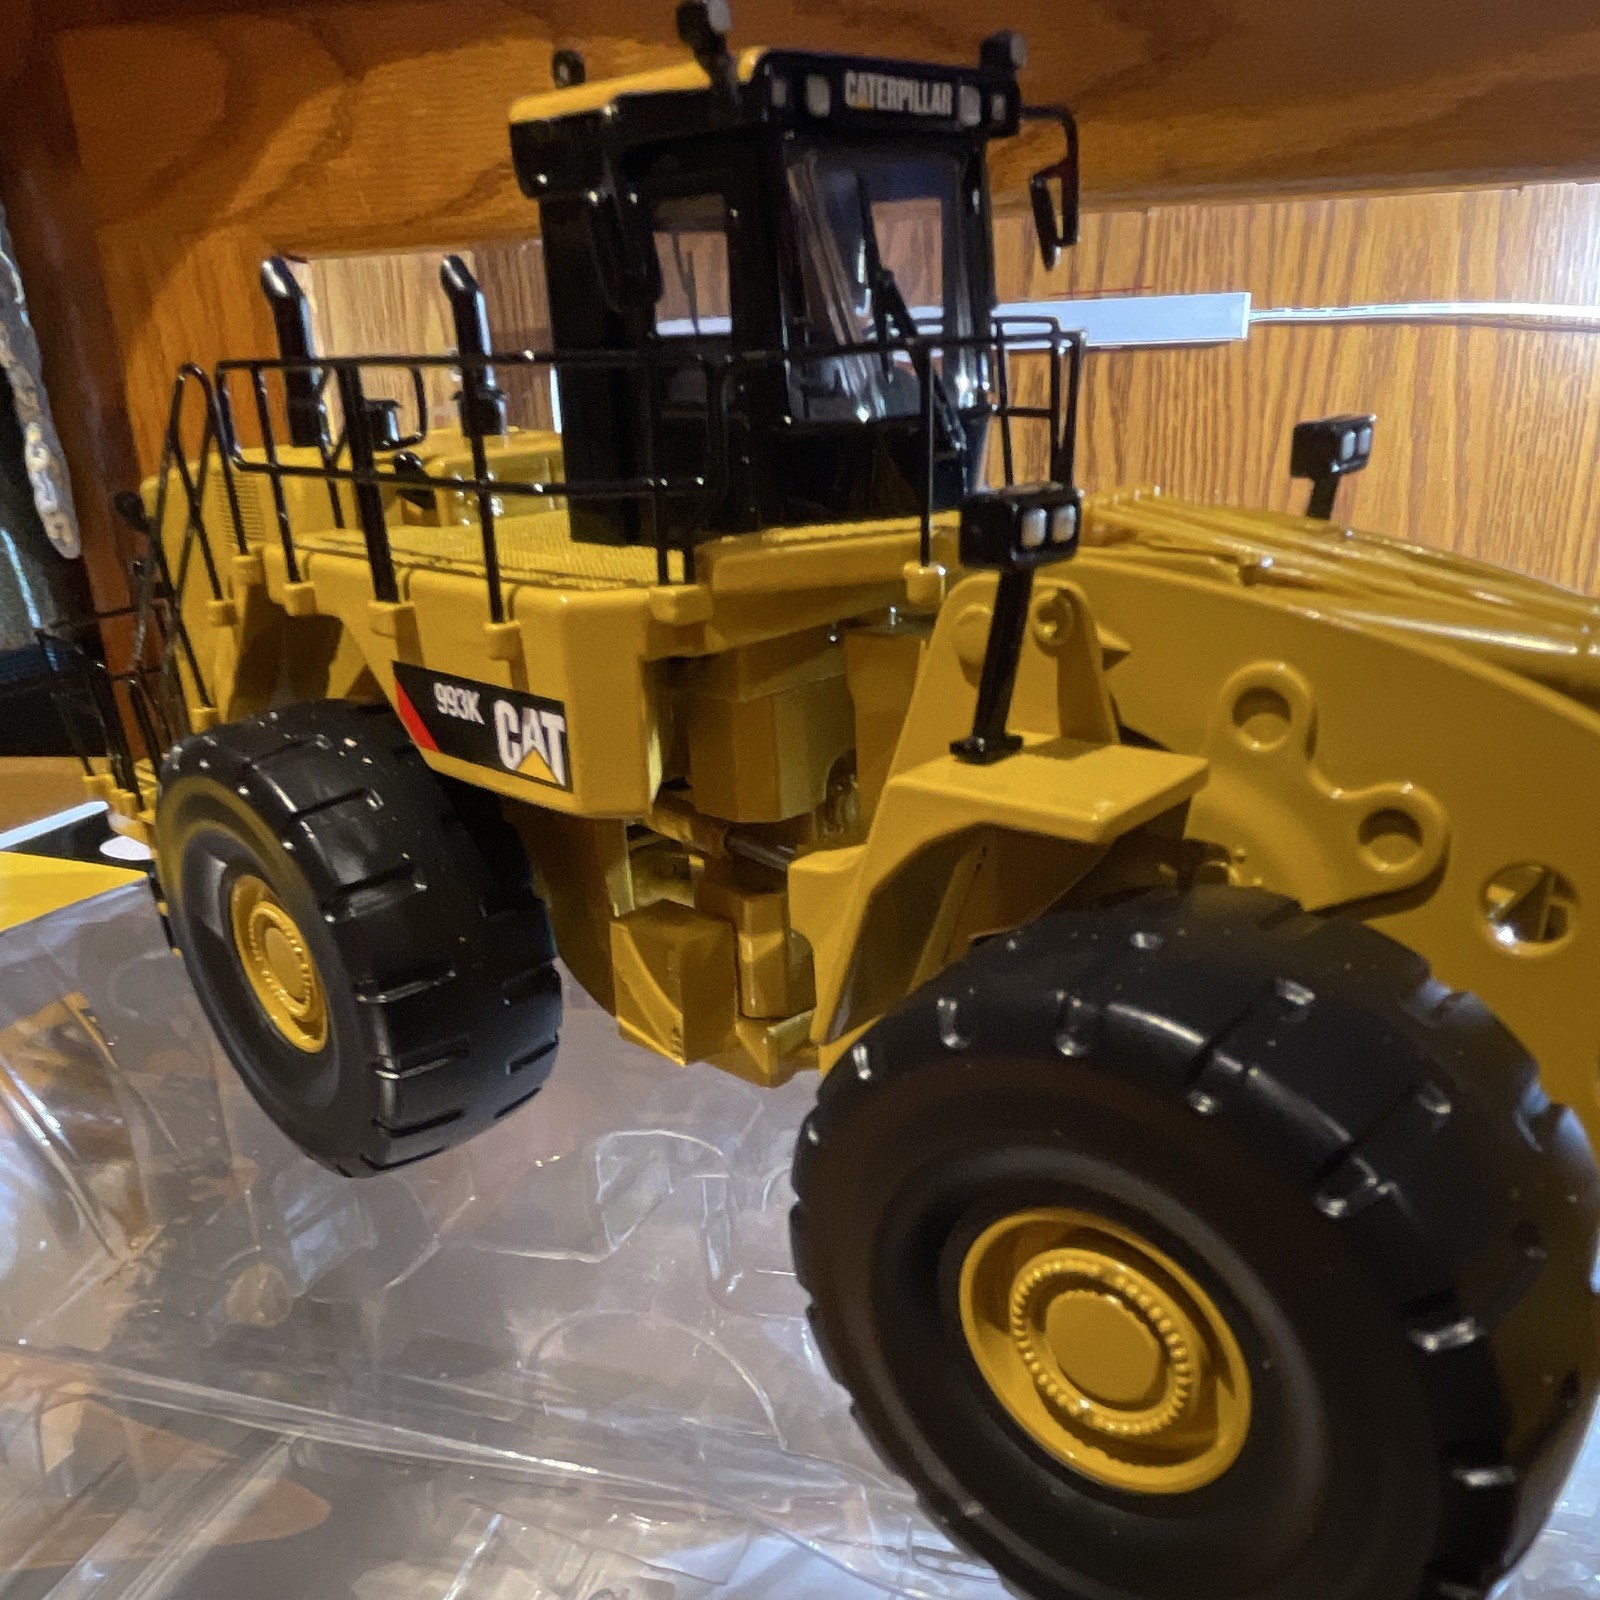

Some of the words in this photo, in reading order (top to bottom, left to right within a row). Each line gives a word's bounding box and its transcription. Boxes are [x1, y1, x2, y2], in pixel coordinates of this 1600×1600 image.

[844, 70, 952, 115] CATERPILLAR
[433, 682, 485, 725] 993K
[494, 700, 566, 786] CAT
